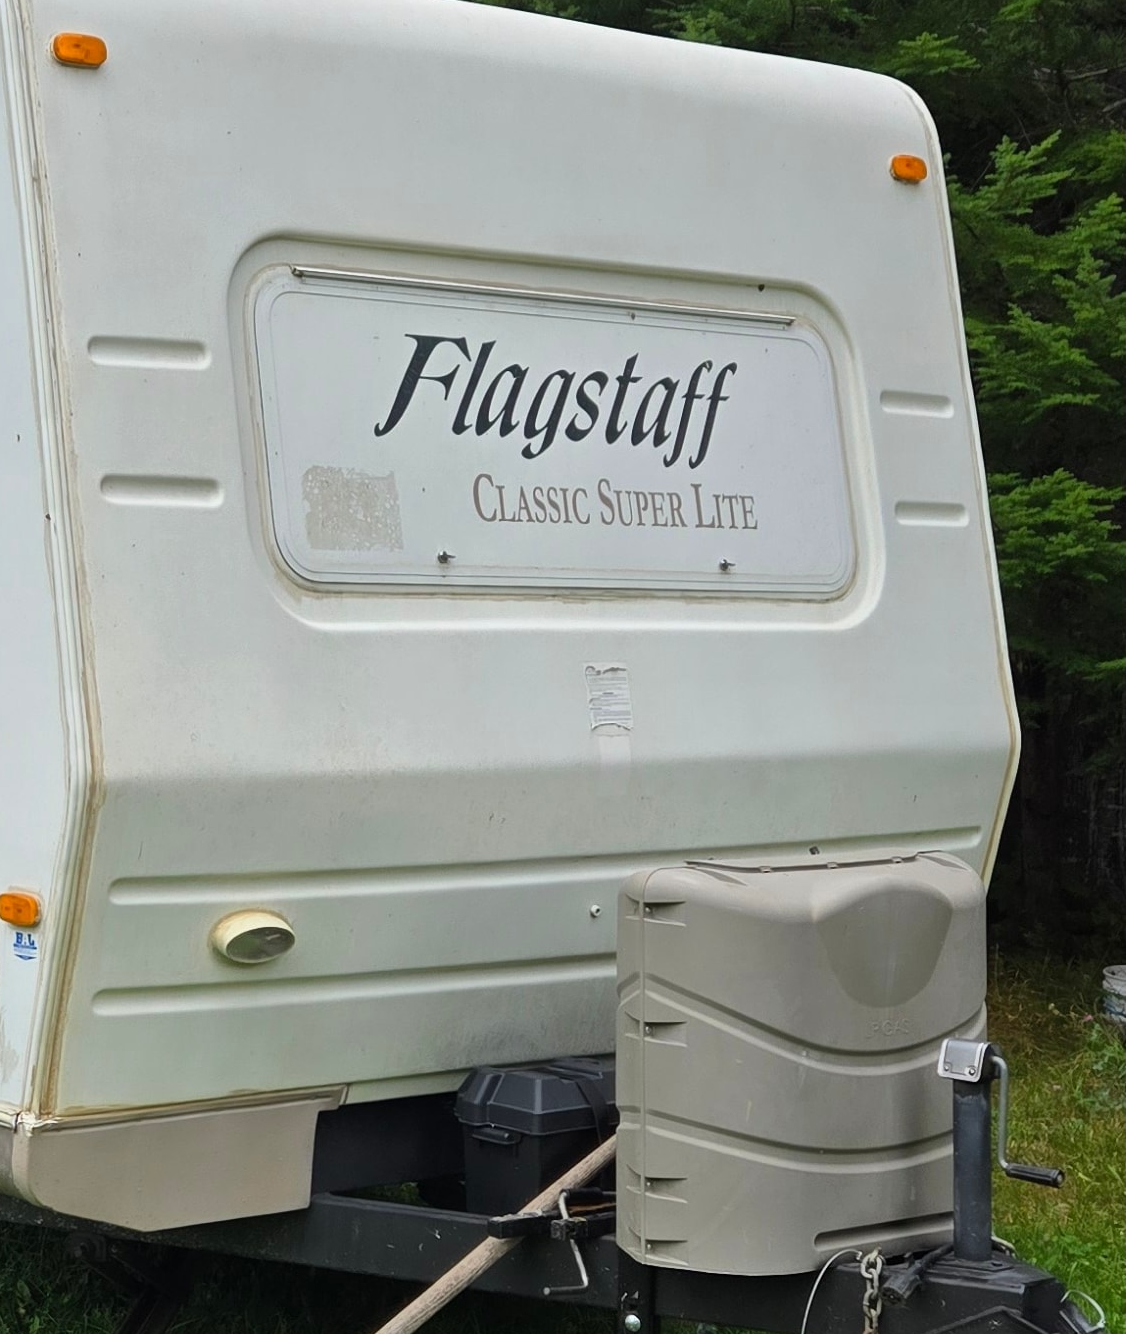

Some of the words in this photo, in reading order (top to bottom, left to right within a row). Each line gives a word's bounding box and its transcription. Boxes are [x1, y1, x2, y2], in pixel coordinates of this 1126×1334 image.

[374, 334, 738, 469] Flagstaff
[473, 473, 591, 525] CLASSIC
[596, 478, 687, 529] SUPER
[691, 483, 759, 531] LITE
